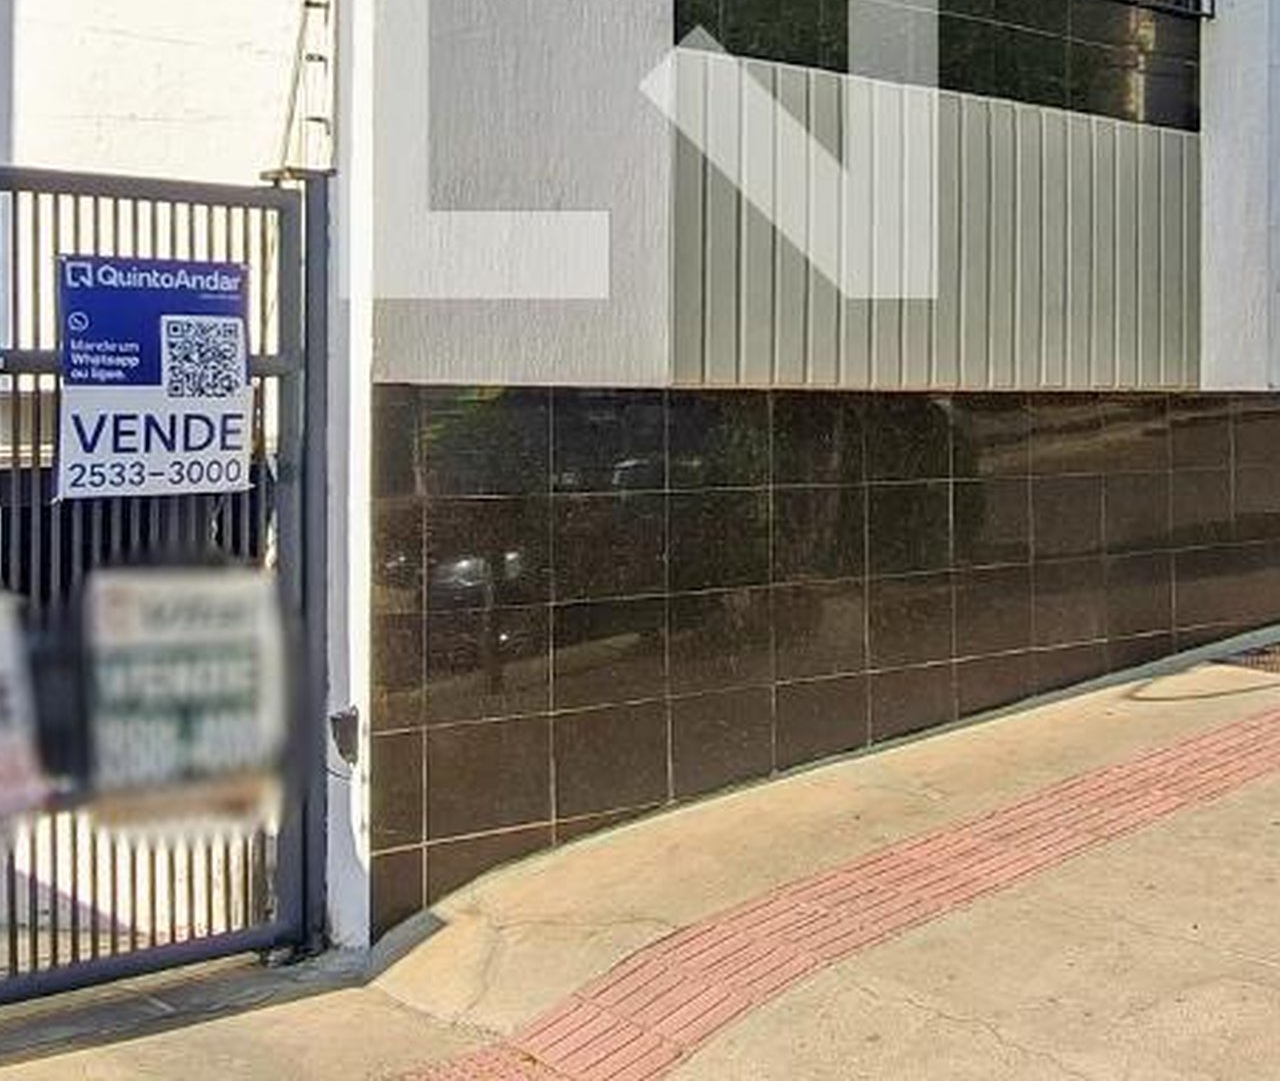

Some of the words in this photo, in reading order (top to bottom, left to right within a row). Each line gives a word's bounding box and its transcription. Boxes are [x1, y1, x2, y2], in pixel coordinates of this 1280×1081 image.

[97, 264, 241, 291] QuintoAndar
[70, 353, 140, 368] Whatsapp
[71, 413, 244, 453] VENDE
[68, 459, 242, 488] 2533-3000
